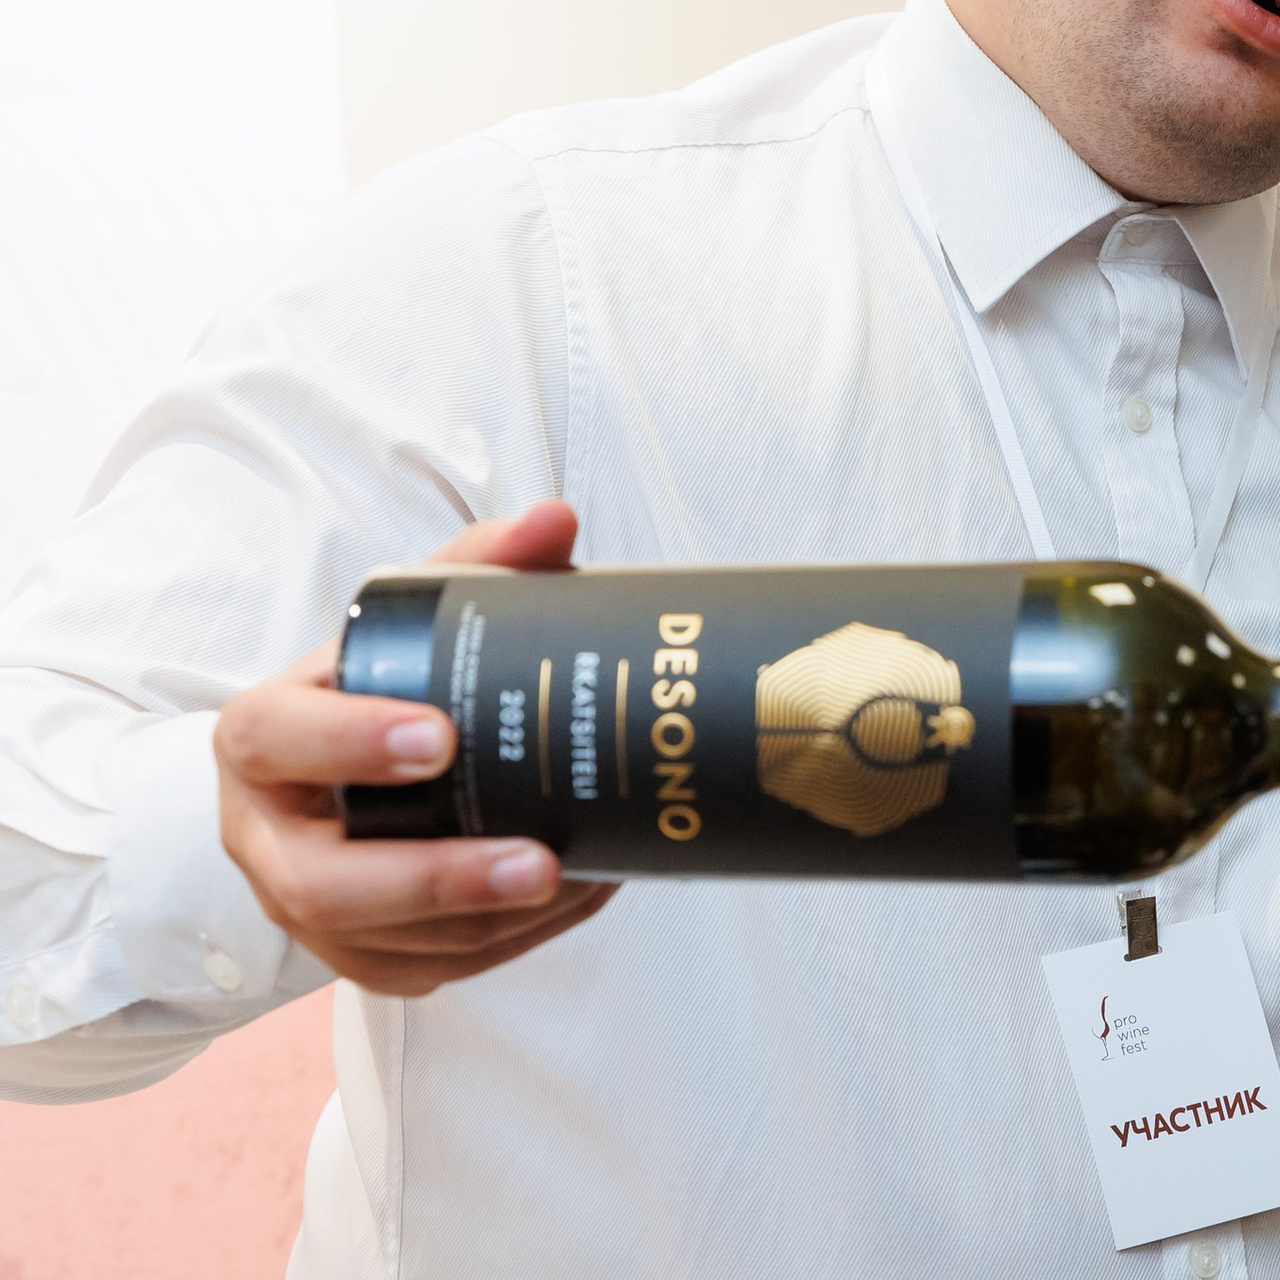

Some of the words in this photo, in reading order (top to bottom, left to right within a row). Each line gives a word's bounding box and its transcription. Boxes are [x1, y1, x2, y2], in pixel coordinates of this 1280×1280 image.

[498, 688, 526, 762] 2022
[570, 651, 600, 800] RKATSITELI
[651, 612, 703, 841] DESONO
[1114, 1013, 1137, 1030] pro
[1117, 1025, 1150, 1041] wine
[1121, 1040, 1147, 1056] fest
[1110, 1086, 1268, 1148] УЧАСТНИК
